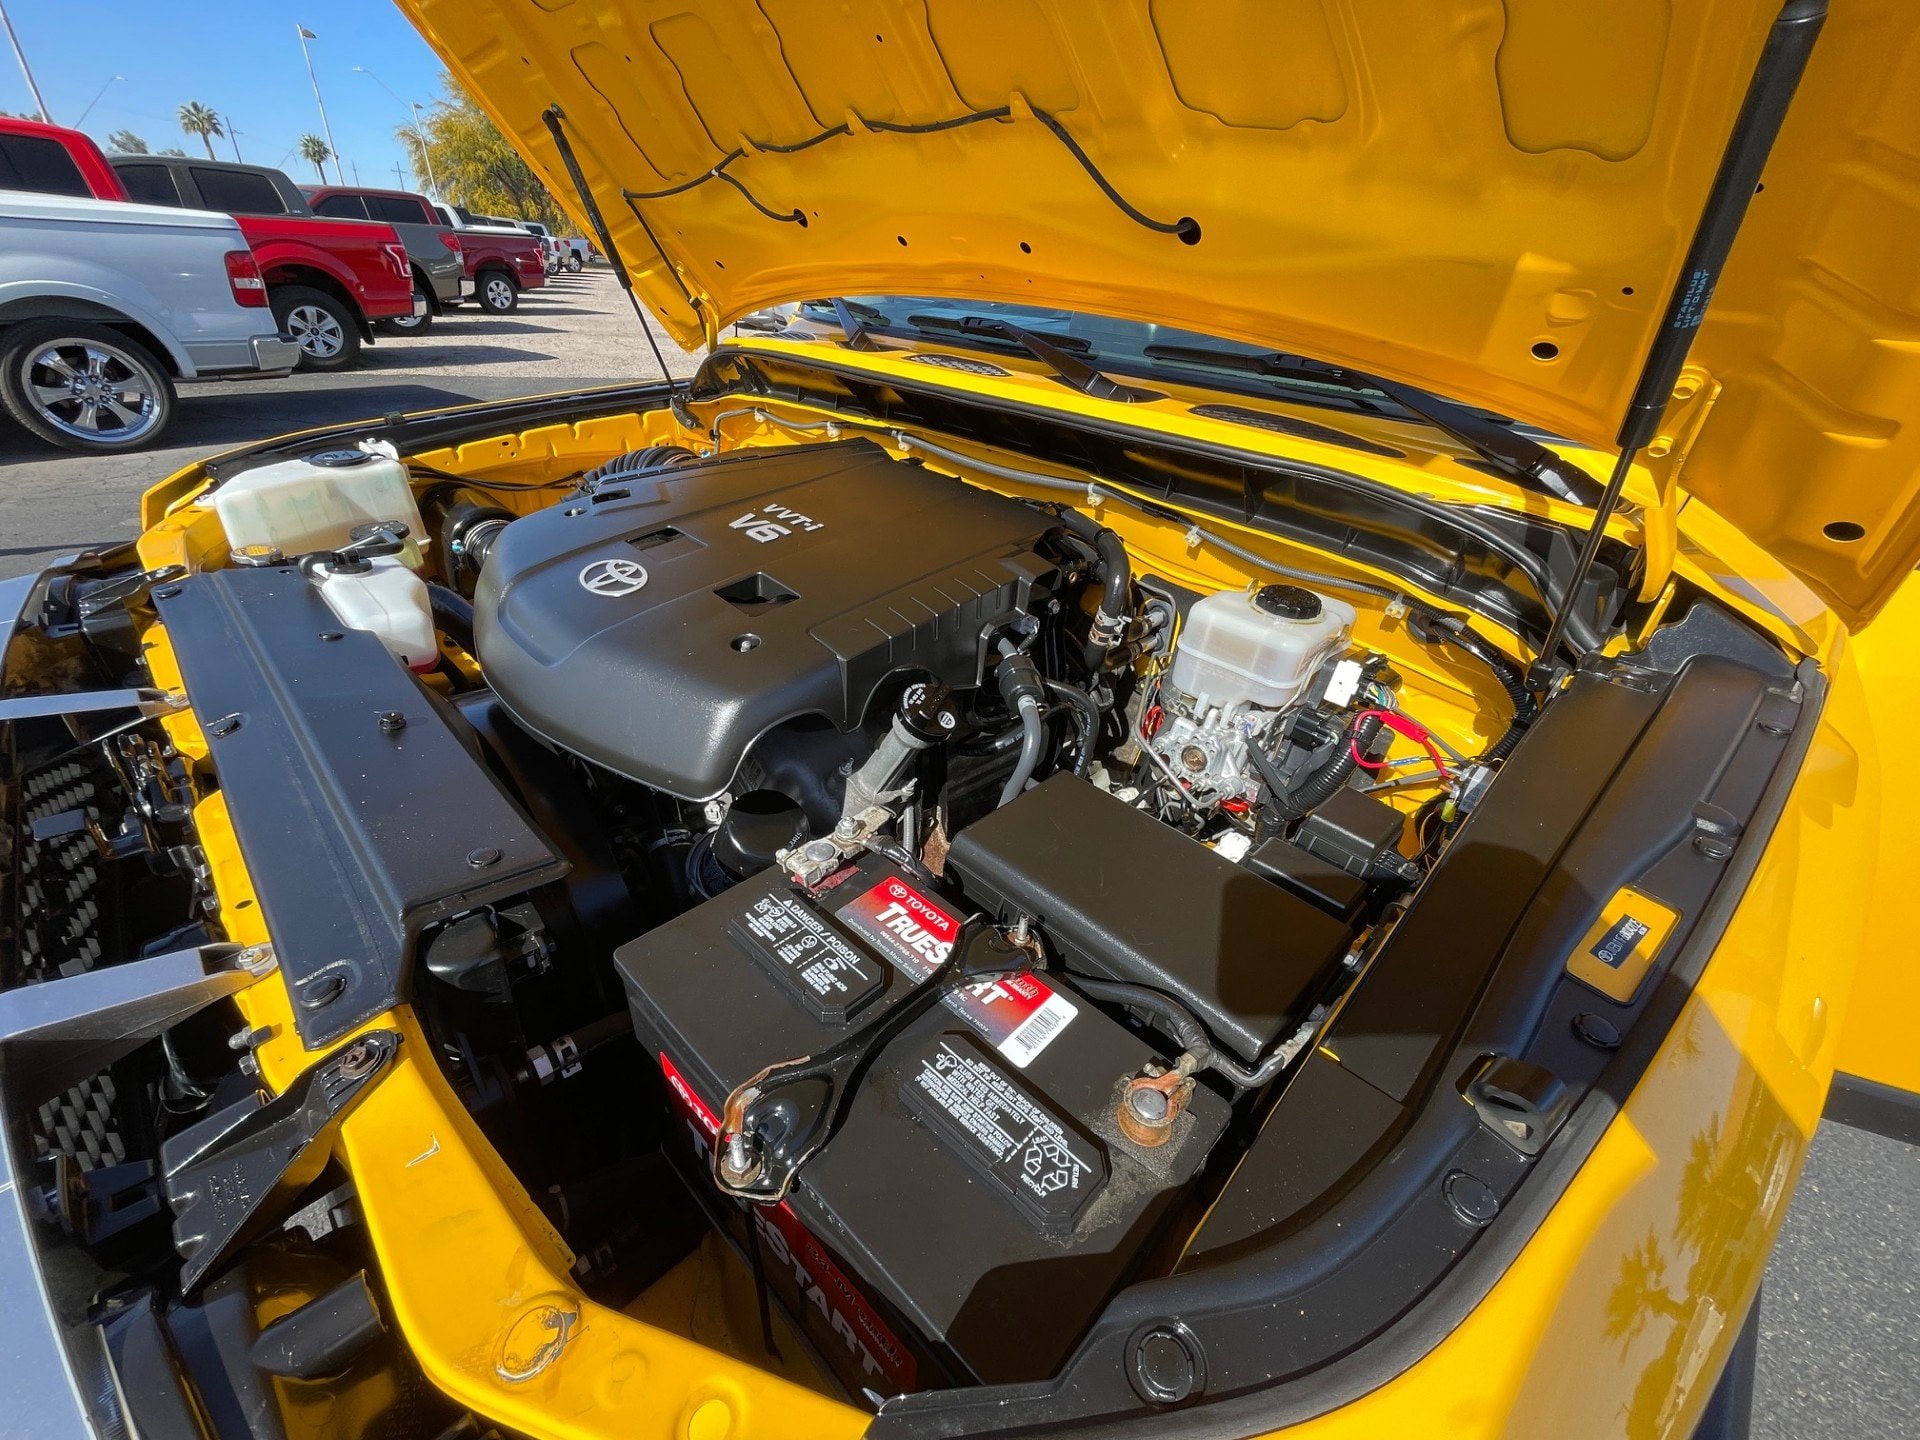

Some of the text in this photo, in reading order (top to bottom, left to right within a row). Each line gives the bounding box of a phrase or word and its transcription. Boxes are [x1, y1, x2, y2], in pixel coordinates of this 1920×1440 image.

[728, 512, 792, 543] V6
[788, 902, 825, 935] DANGER
[825, 933, 861, 966] POISON
[904, 894, 950, 931] TOYOTA
[945, 1073, 1001, 1123] MEDICAL HELP FAST
[950, 1068, 968, 1084] WITH
[983, 1097, 1000, 1112] GET
[955, 1063, 1027, 1126] FLUSH EYES IMMEDIATELY
